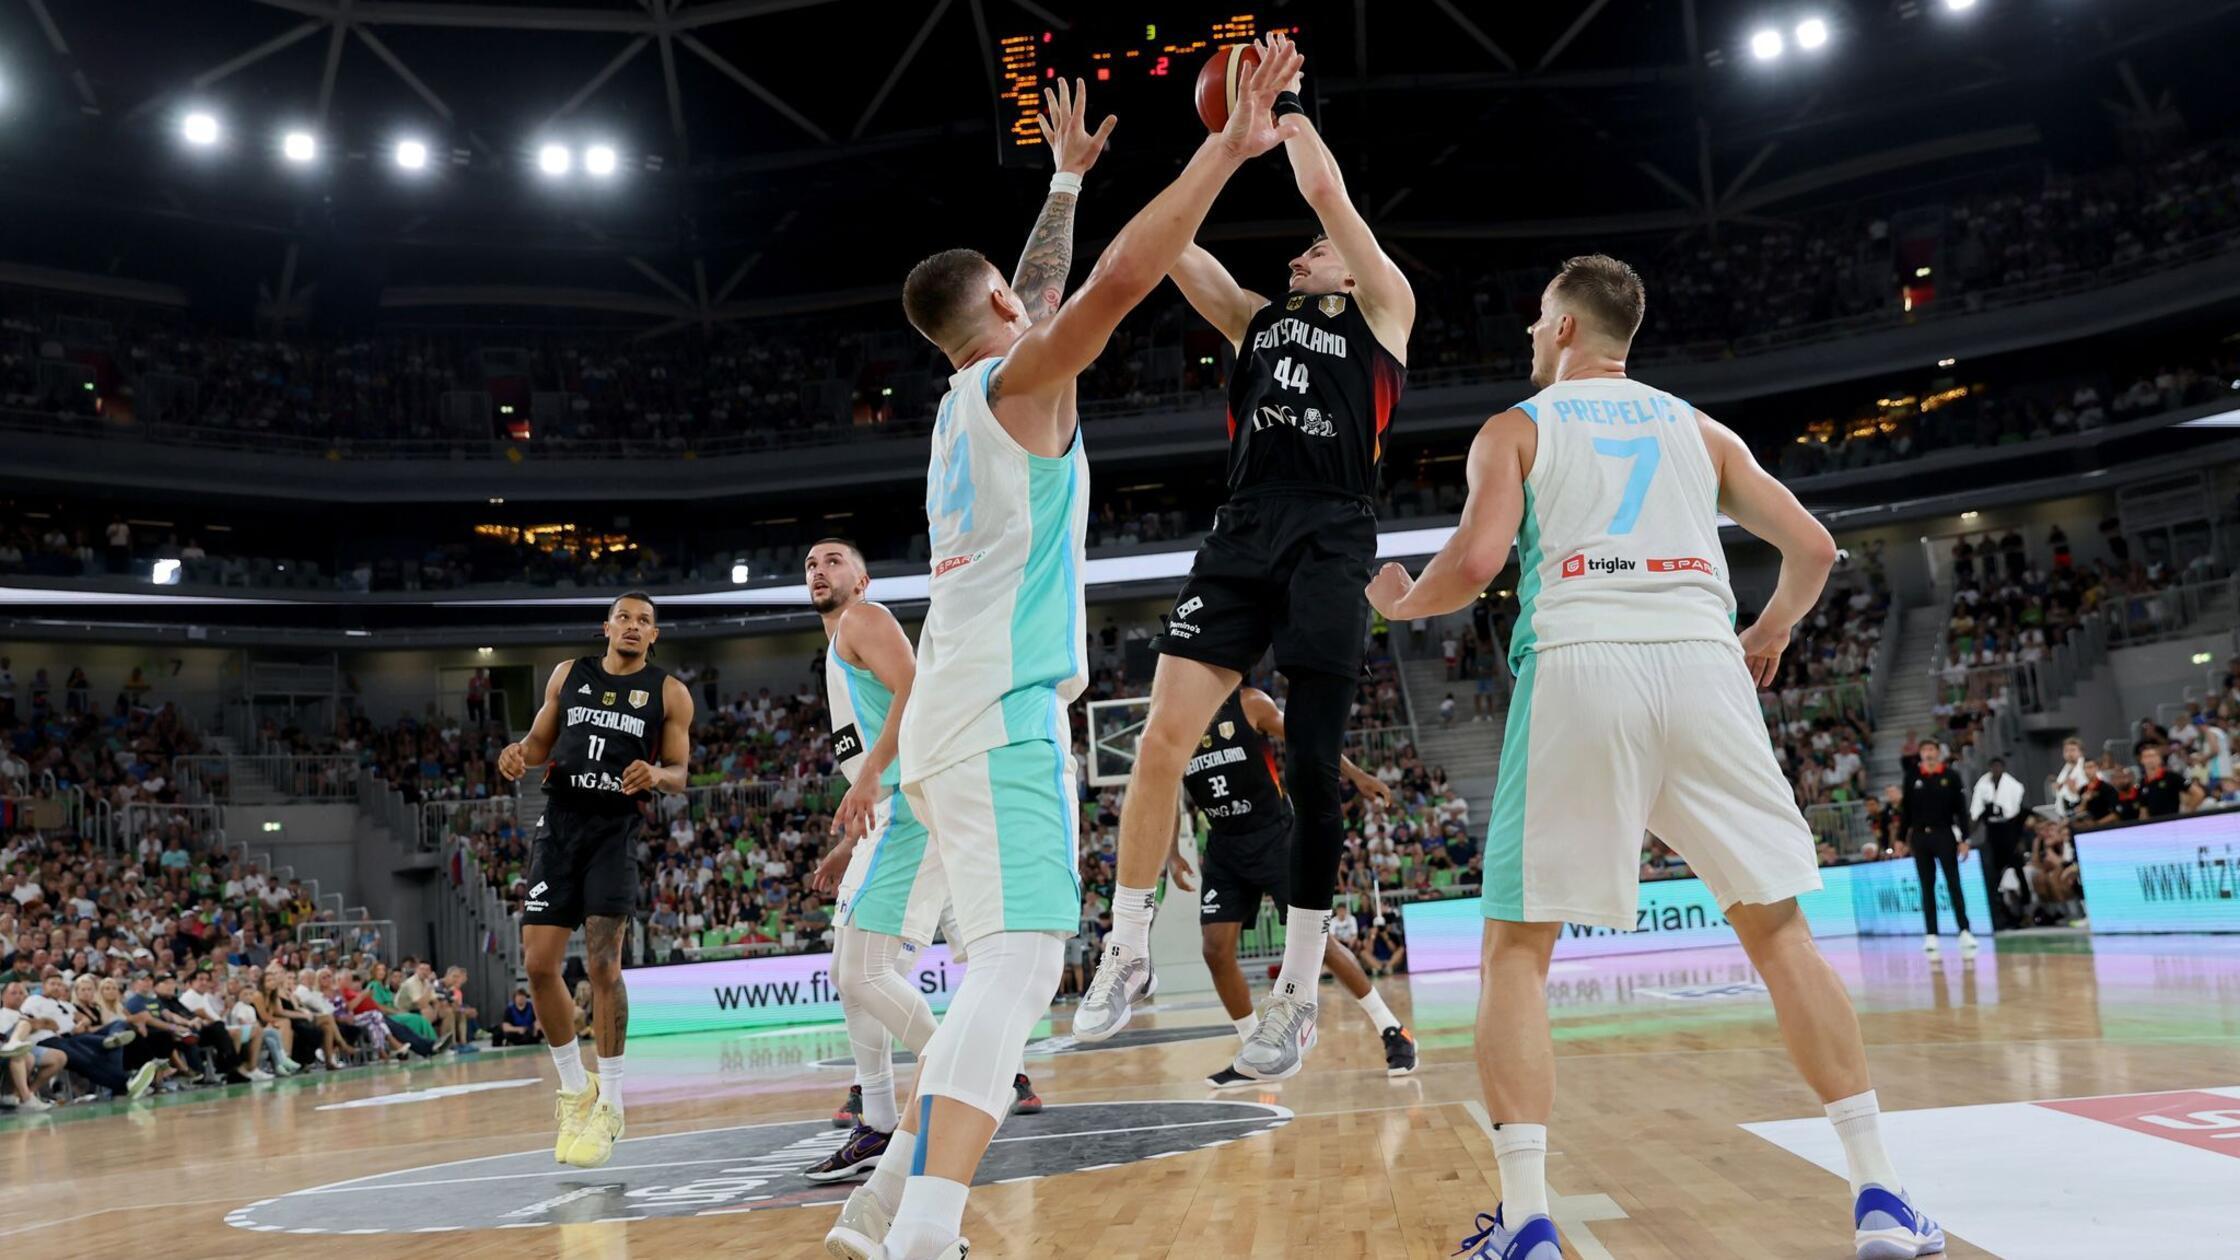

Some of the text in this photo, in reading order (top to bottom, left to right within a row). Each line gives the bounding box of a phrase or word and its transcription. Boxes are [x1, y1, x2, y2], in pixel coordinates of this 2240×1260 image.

[1273, 356, 1310, 394] 44
[1252, 404, 1298, 432] ING
[1592, 436, 1661, 536] 7
[1588, 556, 1636, 574] triglav
[567, 706, 646, 738] DEUTSCHLAND
[588, 735, 606, 762] 11
[571, 772, 597, 789] ING
[1208, 775, 1230, 798] 32
[1205, 805, 1230, 818] ING
